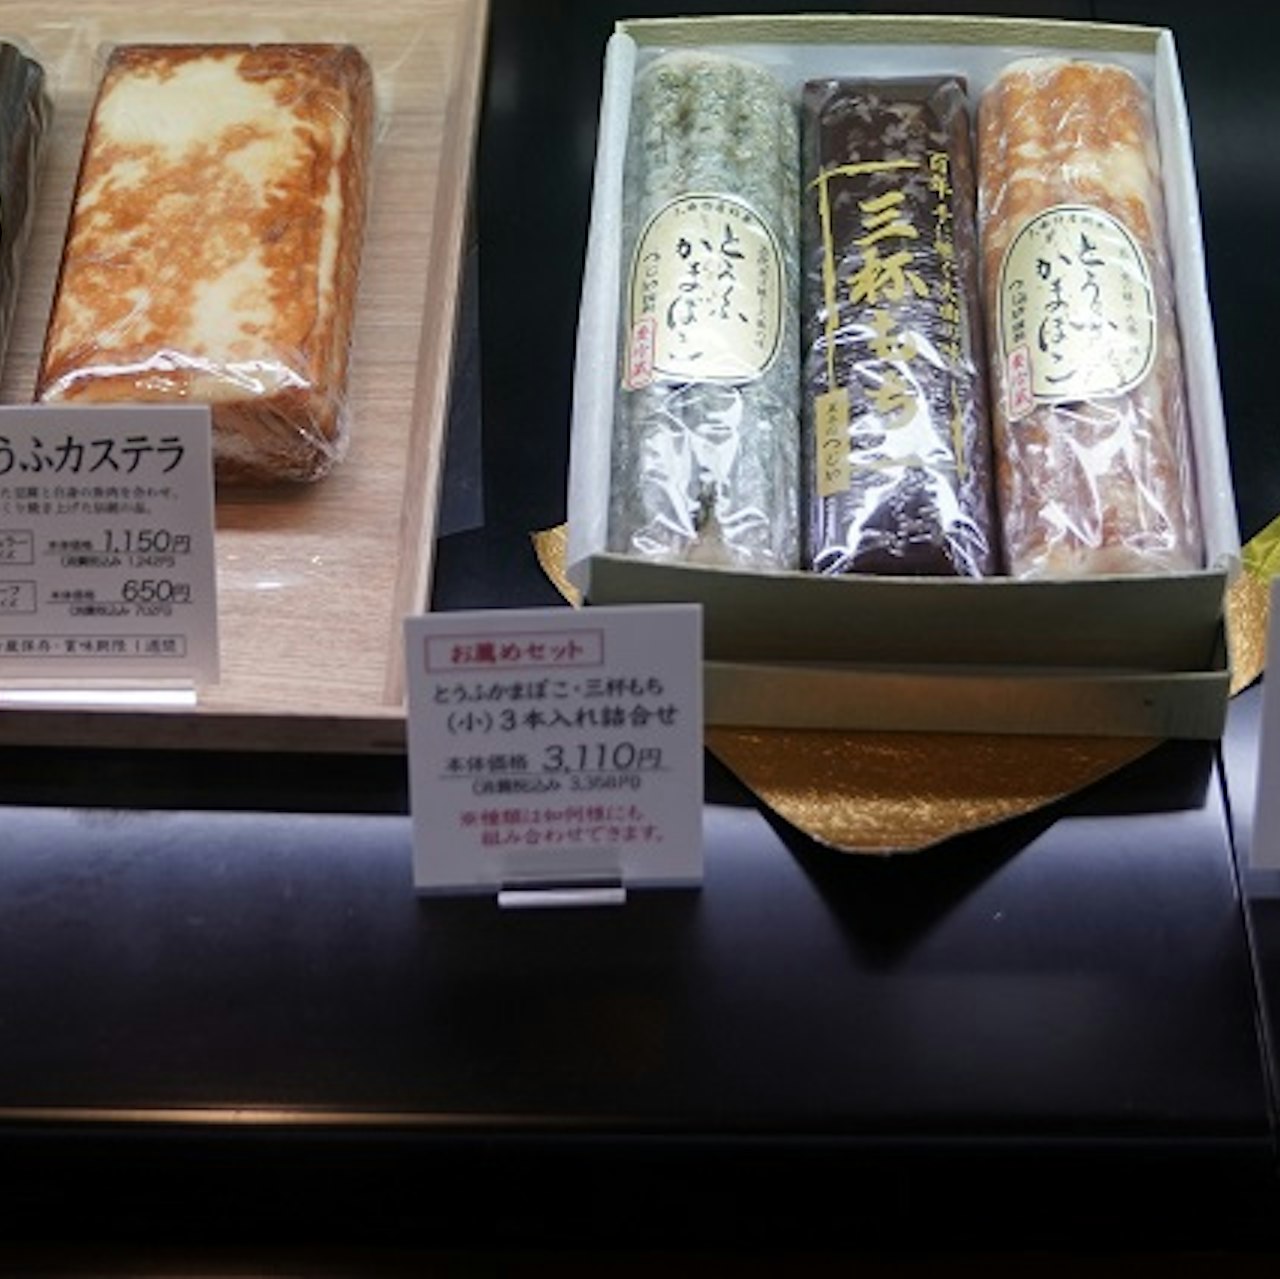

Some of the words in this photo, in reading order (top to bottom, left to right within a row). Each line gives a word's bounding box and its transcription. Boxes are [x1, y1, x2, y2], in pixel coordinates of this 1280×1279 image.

[846, 190, 930, 431] 三杯もち
[121, 578, 192, 604] 650円
[450, 638, 584, 665] お薦めセット
[446, 755, 529, 774] 本体価格
[542, 741, 663, 775] 3,110円
